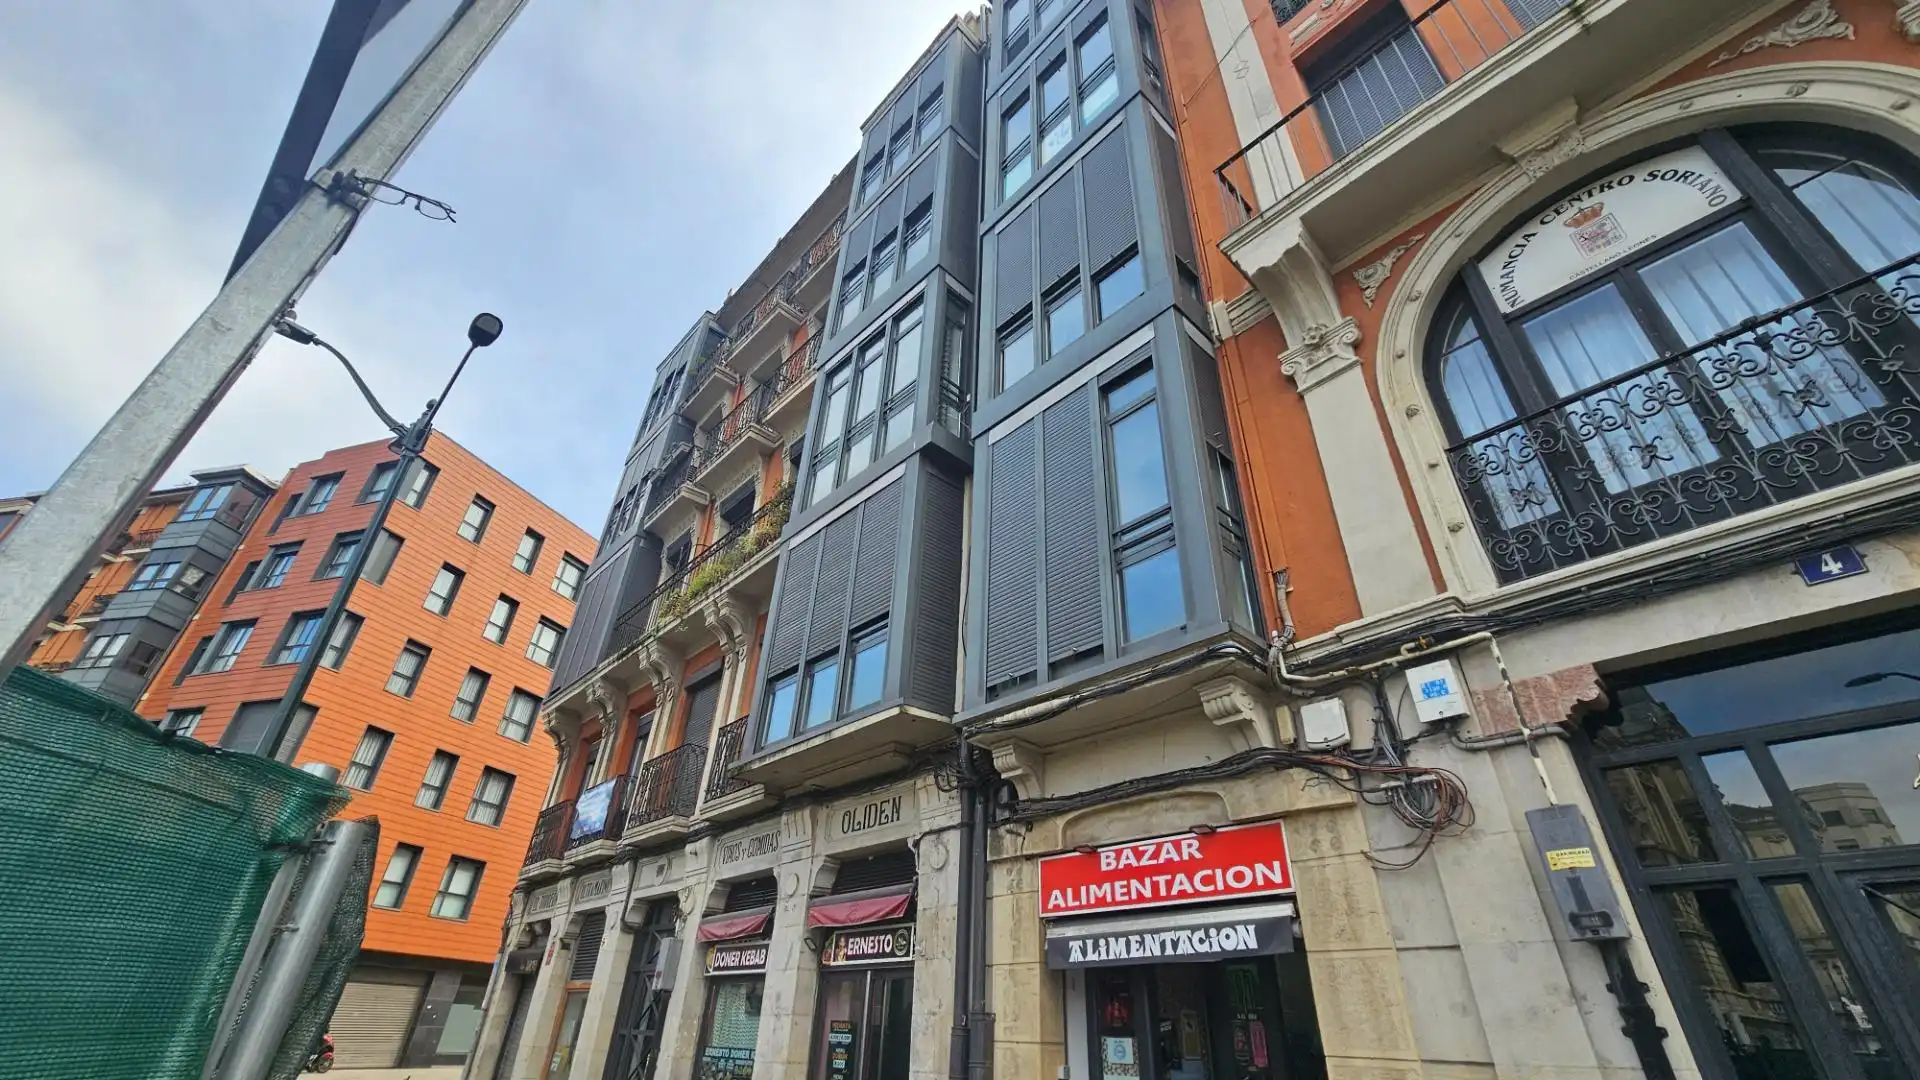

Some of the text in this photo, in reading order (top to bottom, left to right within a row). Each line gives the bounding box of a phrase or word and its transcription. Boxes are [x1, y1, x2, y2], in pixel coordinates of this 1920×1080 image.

[1499, 168, 1728, 309] NUMANCIA CENTRO SORIANO
[1821, 552, 1844, 575] 4
[841, 796, 902, 835] OLIDEN
[747, 830, 781, 858] COMIDAS
[1100, 838, 1203, 872] BAZAR
[1047, 860, 1283, 910] ALIMENTACION
[714, 948, 767, 968] DONER KEBAB
[847, 934, 893, 955] ERNESTO
